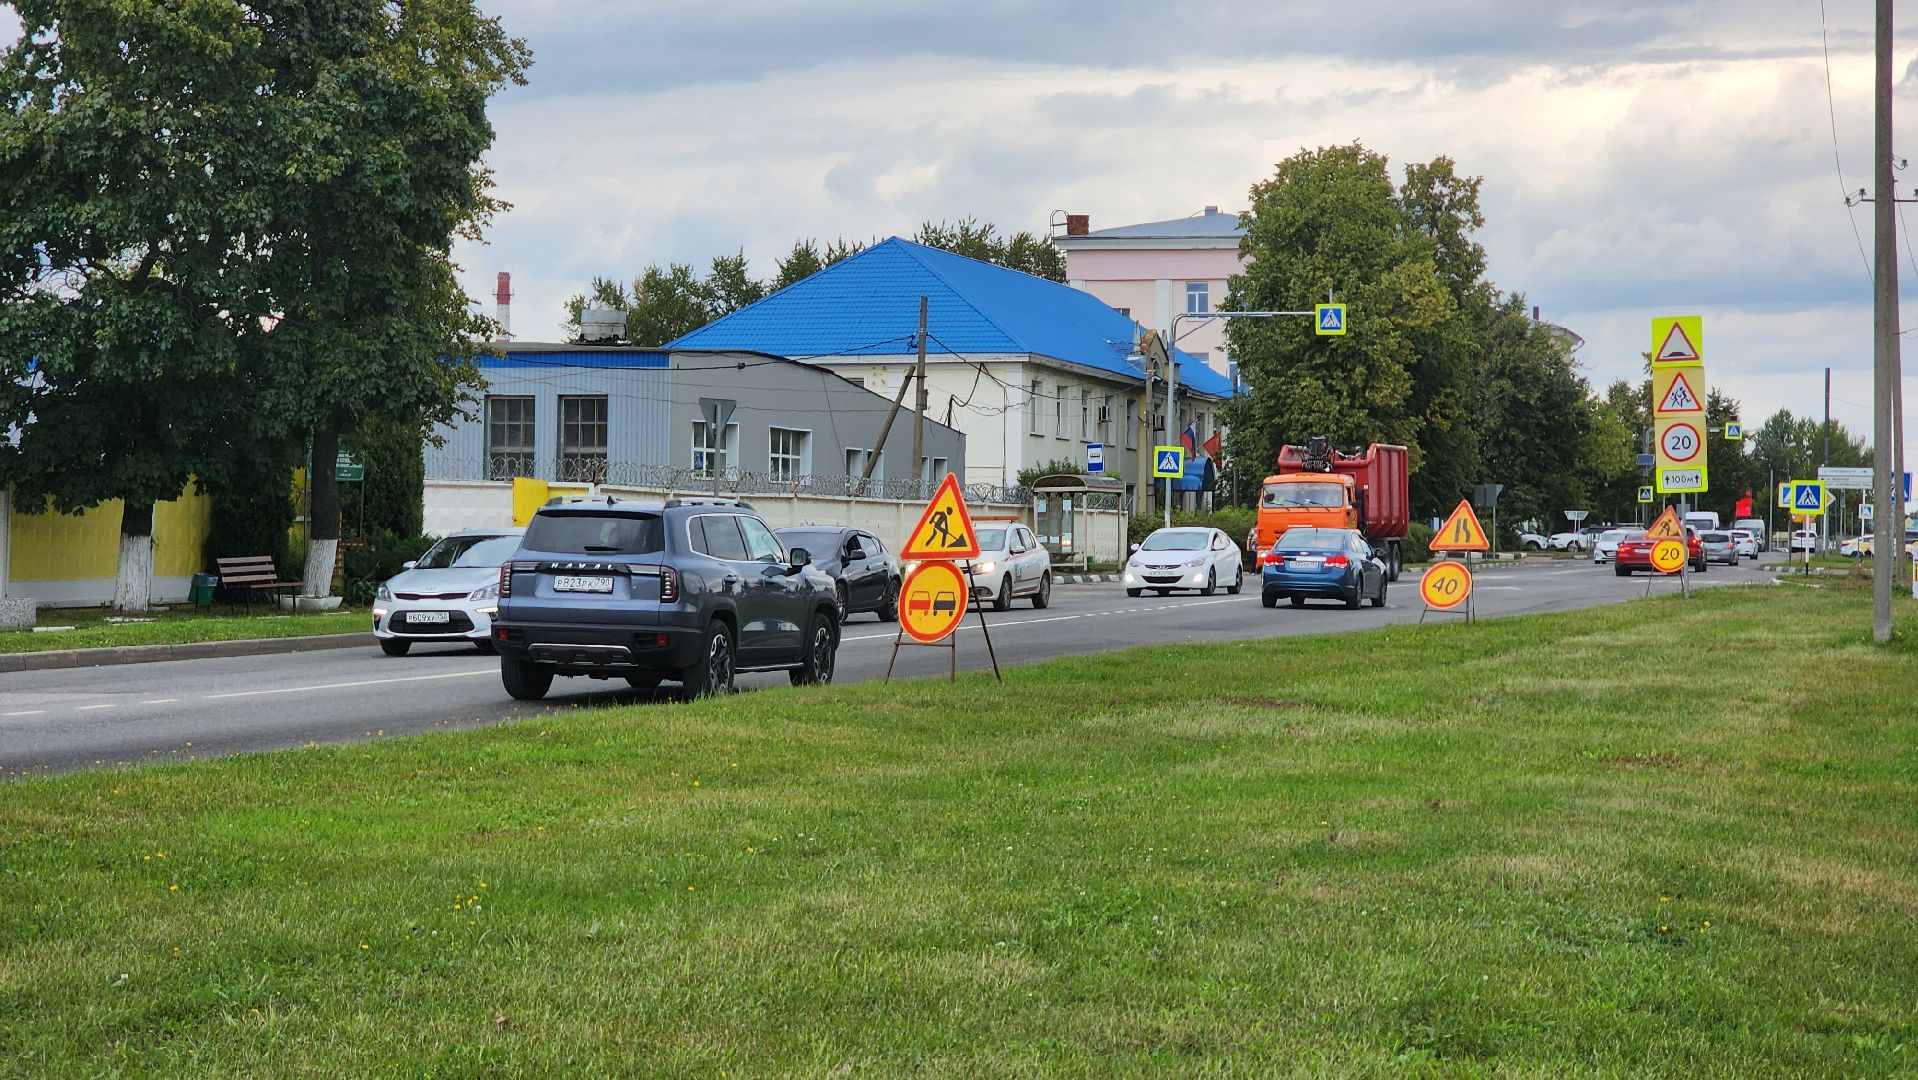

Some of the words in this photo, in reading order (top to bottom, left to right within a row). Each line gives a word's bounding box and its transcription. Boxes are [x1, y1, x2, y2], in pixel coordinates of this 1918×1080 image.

[1671, 435, 1692, 450] 20
[1660, 547, 1680, 561] 20
[551, 562, 614, 571] HAVAL
[1432, 576, 1458, 595] 40
